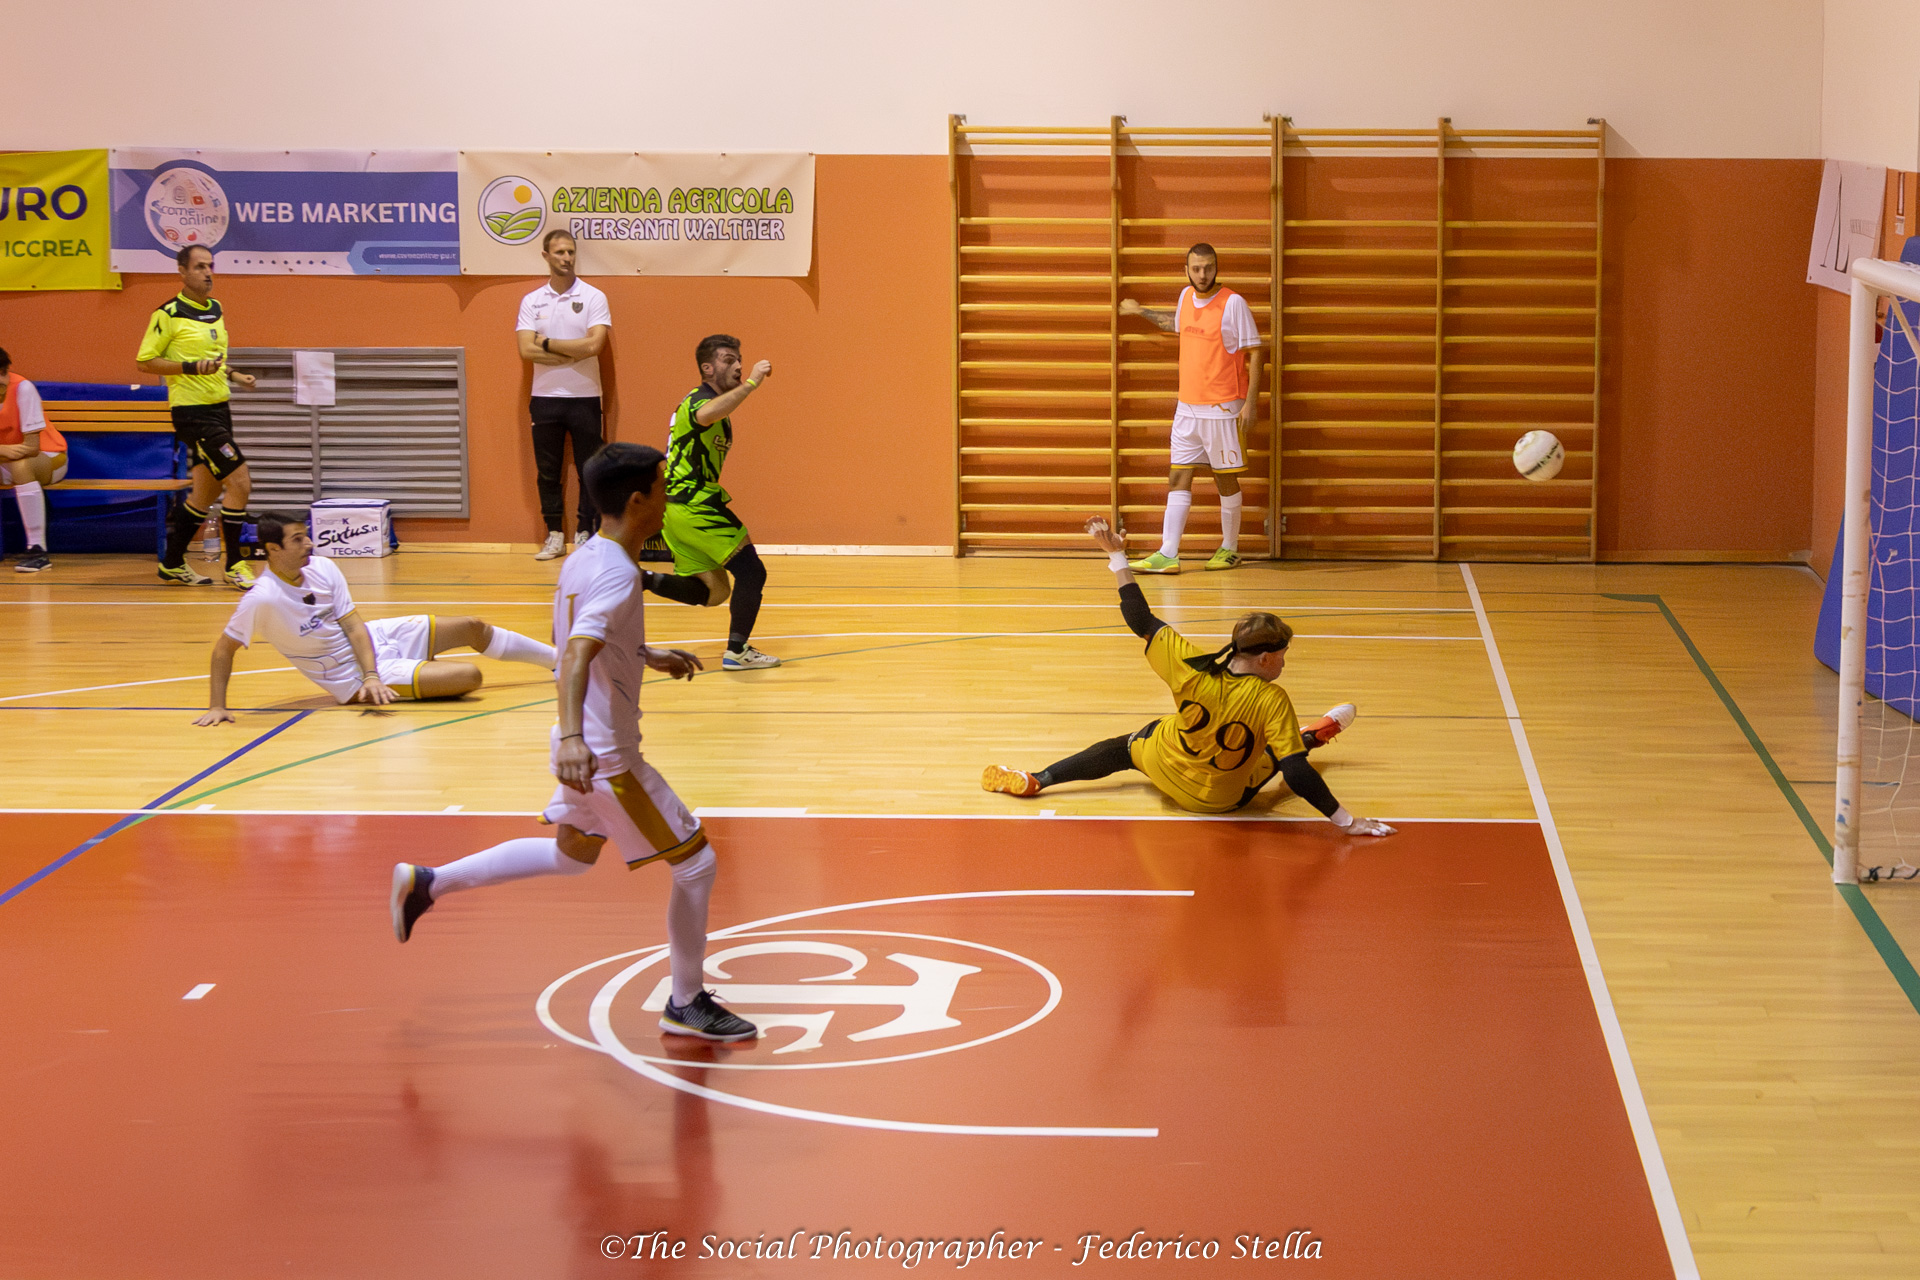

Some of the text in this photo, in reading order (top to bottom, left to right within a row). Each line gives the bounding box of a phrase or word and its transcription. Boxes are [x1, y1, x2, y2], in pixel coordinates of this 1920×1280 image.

[552, 187, 794, 213] AZIENDA AGRICOLA
[179, 213, 219, 225] online
[234, 202, 456, 224] WEB MARKETING
[569, 217, 785, 240] PIERSANTI WALTHER
[5, 239, 93, 258] ICCREA
[1178, 699, 1256, 772] 29
